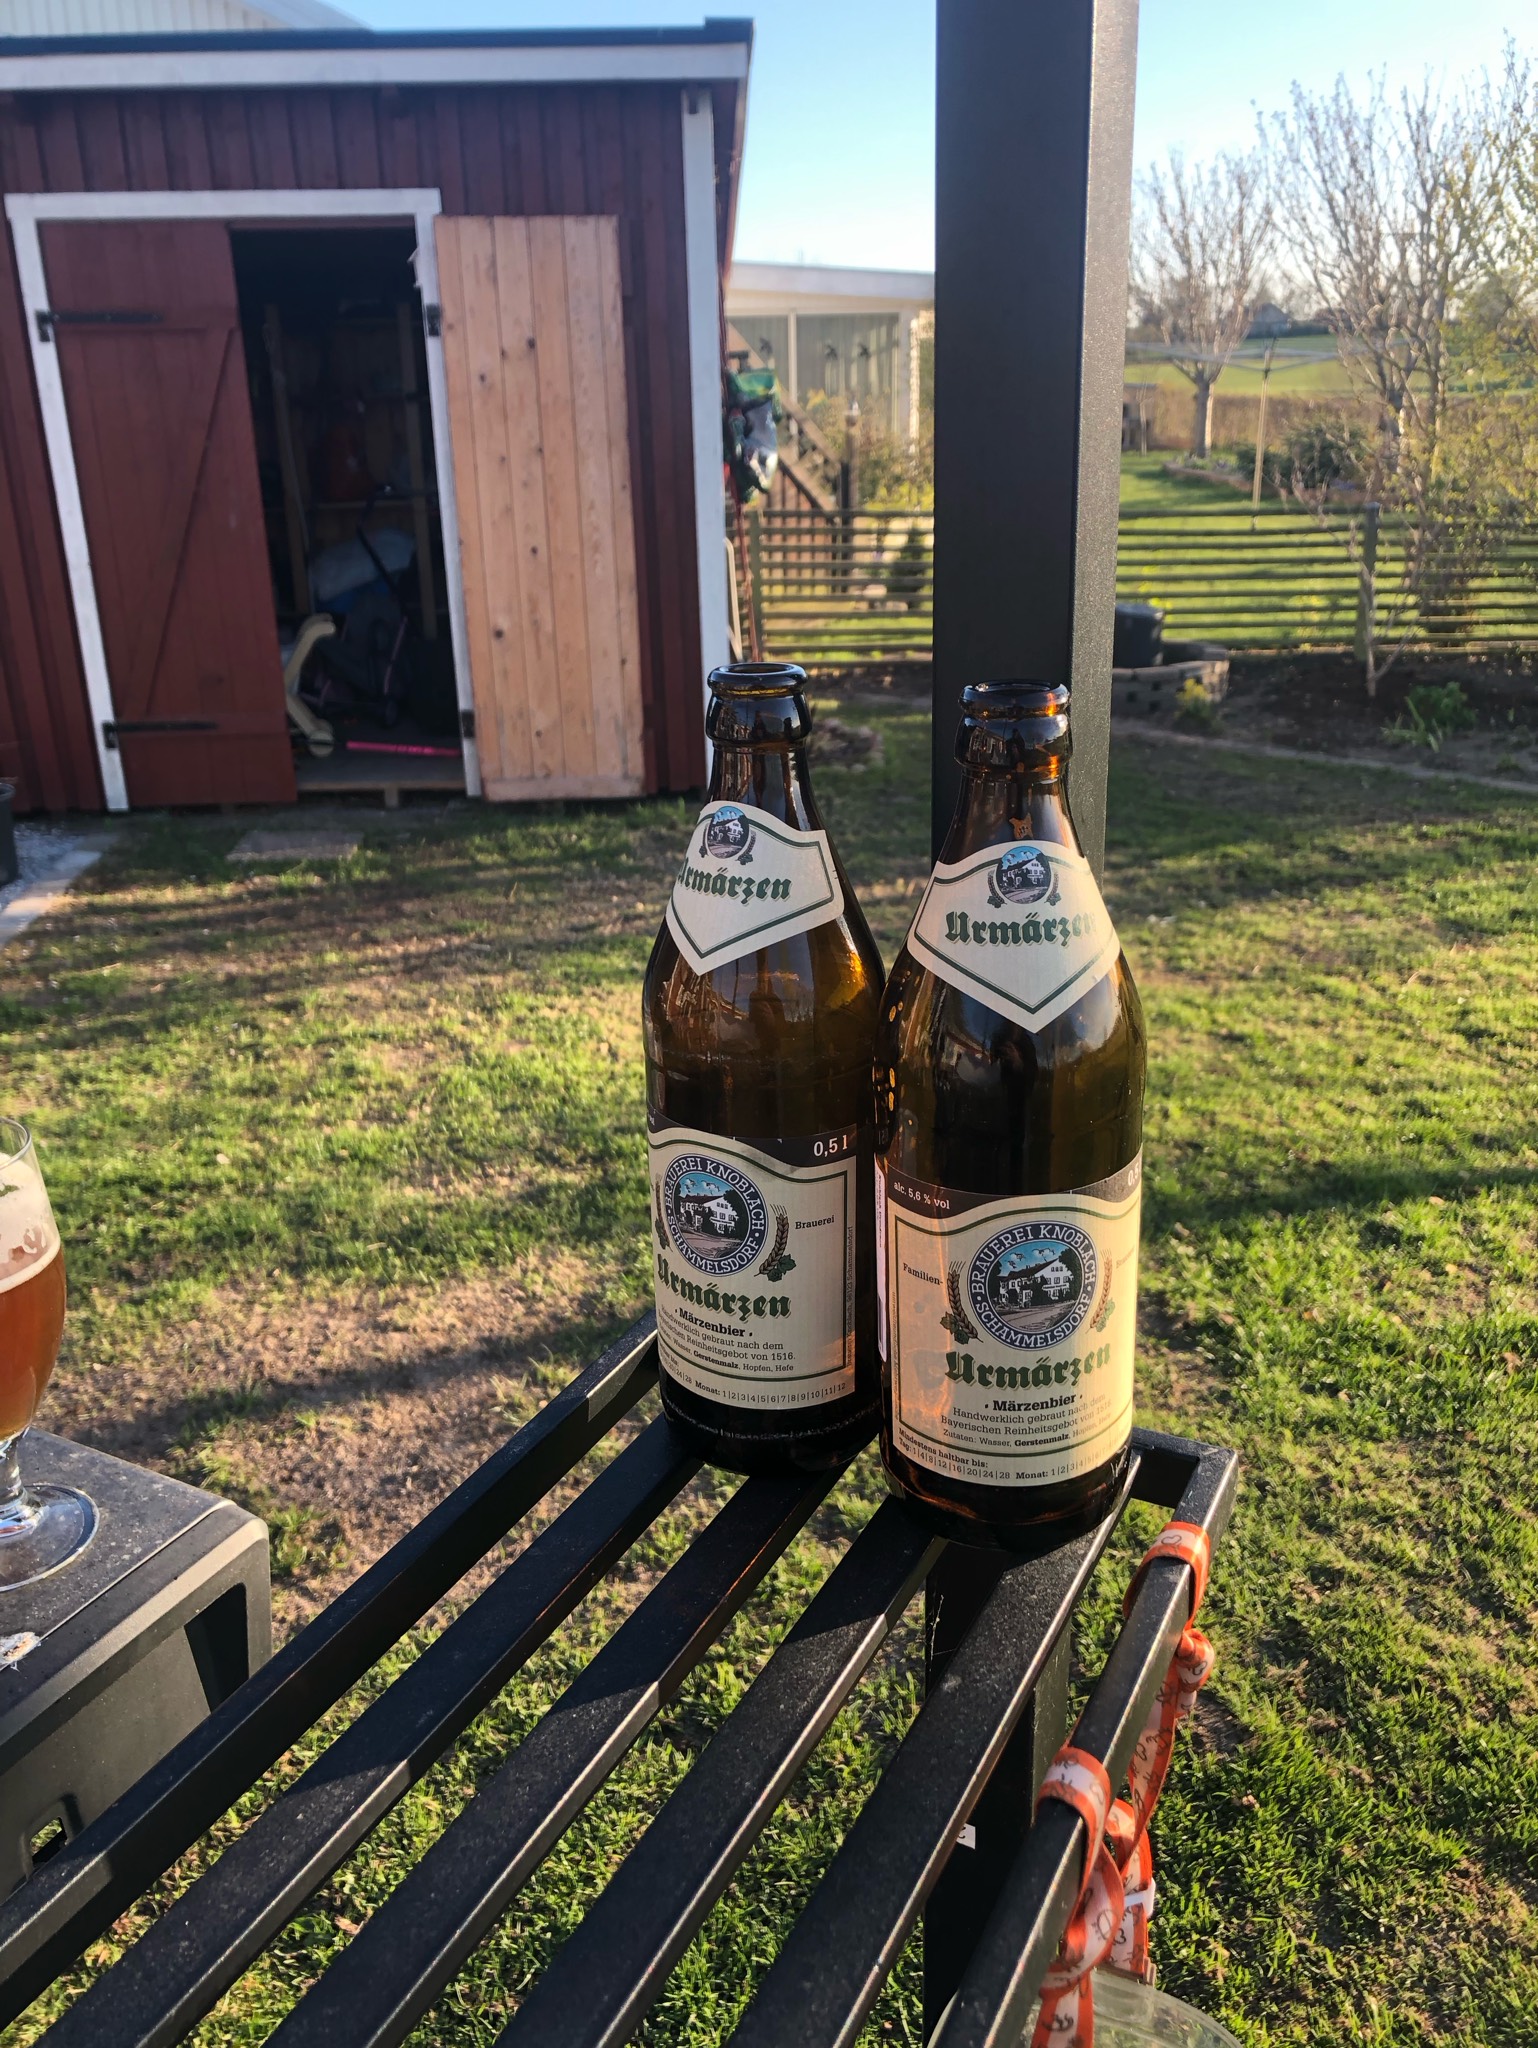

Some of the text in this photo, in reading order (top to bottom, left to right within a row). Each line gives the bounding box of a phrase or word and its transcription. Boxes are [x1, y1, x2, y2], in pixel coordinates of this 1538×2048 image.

[813, 1140, 838, 1158] 0,5
[664, 1157, 765, 1231] BRAUEREI KNOBLACH
[893, 1181, 950, 1210] alc. 5,6 % vol
[795, 1214, 835, 1230] Brauerei
[668, 1216, 759, 1274] SCHAMMELSDORF
[971, 1225, 1096, 1294] BRAUEREI KNOBLACH
[903, 1262, 943, 1286] Familien-
[657, 1254, 791, 1321] Urmärzen
[679, 1307, 745, 1337] Märzenbier
[975, 1293, 1092, 1347] SCHAMMELSDORF
[686, 1335, 748, 1359] Reinheitsgebot
[772, 1352, 795, 1361] 1516.
[701, 1333, 735, 1346] gebraut
[737, 1341, 760, 1350] nach
[762, 1342, 784, 1350] dem
[693, 1350, 741, 1369] Gerstenmalz,
[743, 1363, 774, 1372] Hopfen,
[775, 1364, 794, 1372] Hefe
[945, 1343, 1110, 1388] Urmärzen
[695, 1380, 720, 1395] Monat:
[953, 1407, 1025, 1424] Handwerklich
[1027, 1410, 1066, 1424] gebraut
[1068, 1403, 1088, 1416] nach
[992, 1394, 1077, 1412] Märzenbier
[941, 1415, 1001, 1435] Bayerischen
[1004, 1418, 1078, 1435] Reinheitsgebot
[1080, 1411, 1094, 1422] von
[898, 1428, 988, 1468] Mindestens haltbar bis:
[943, 1428, 977, 1443] Zutaten:
[979, 1437, 1012, 1447] Wasser,
[1014, 1433, 1071, 1447] Gerstenmalz,
[898, 1437, 912, 1452] Tag:
[1015, 1471, 1049, 1480] Monat:
